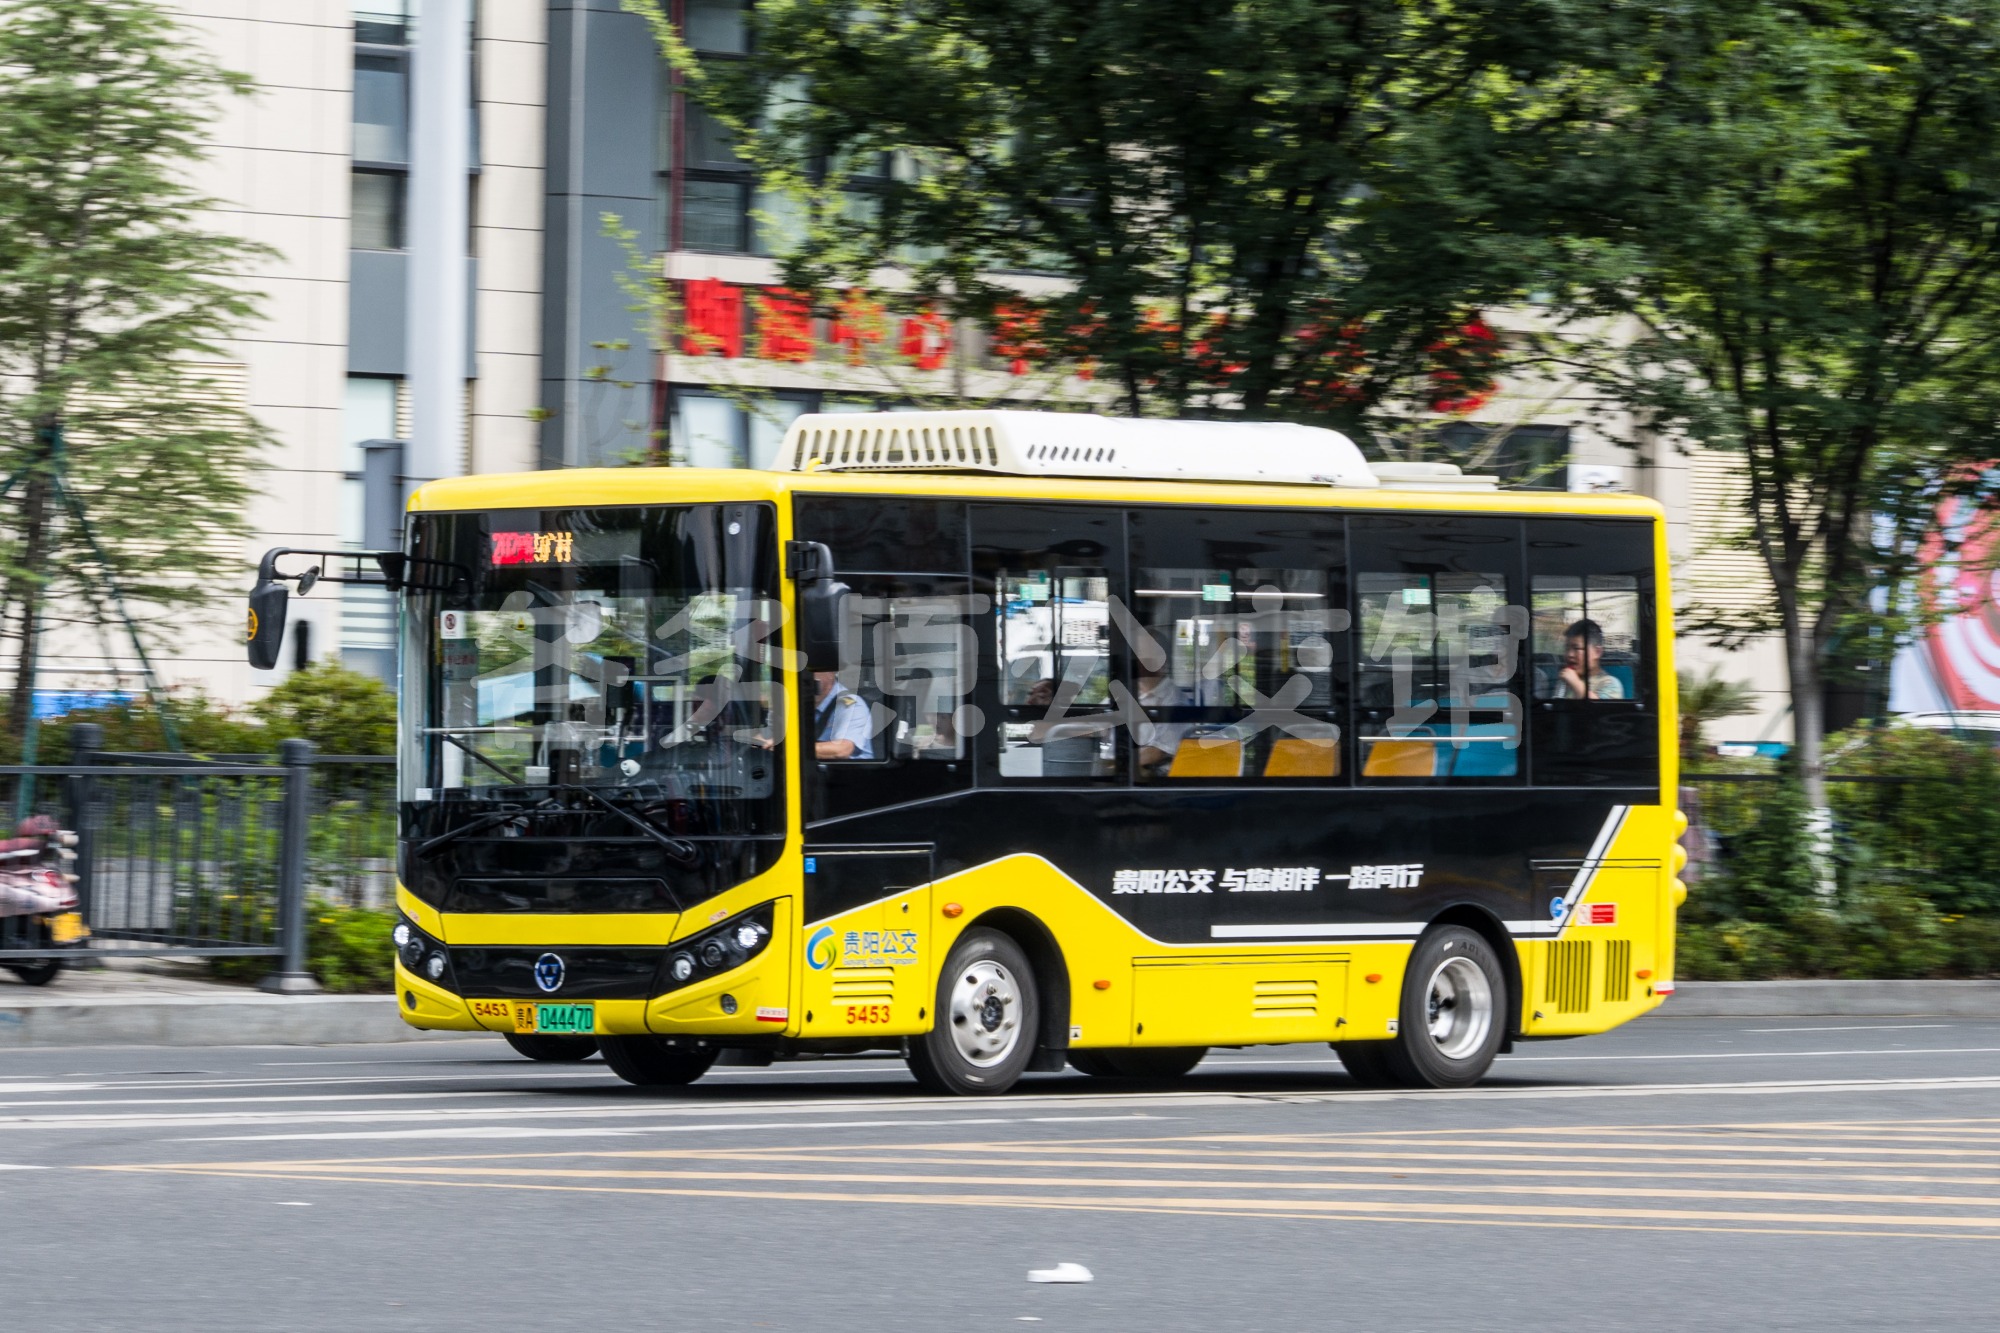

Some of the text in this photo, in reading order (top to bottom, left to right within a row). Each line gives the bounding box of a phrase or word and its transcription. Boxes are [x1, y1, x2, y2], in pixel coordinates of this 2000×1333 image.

[1112, 863, 1424, 894] 贵阳公交 与您相伴 一路同行
[843, 930, 918, 955] 贵阳公交
[474, 1003, 509, 1017] 5453
[846, 1005, 892, 1025] 5453
